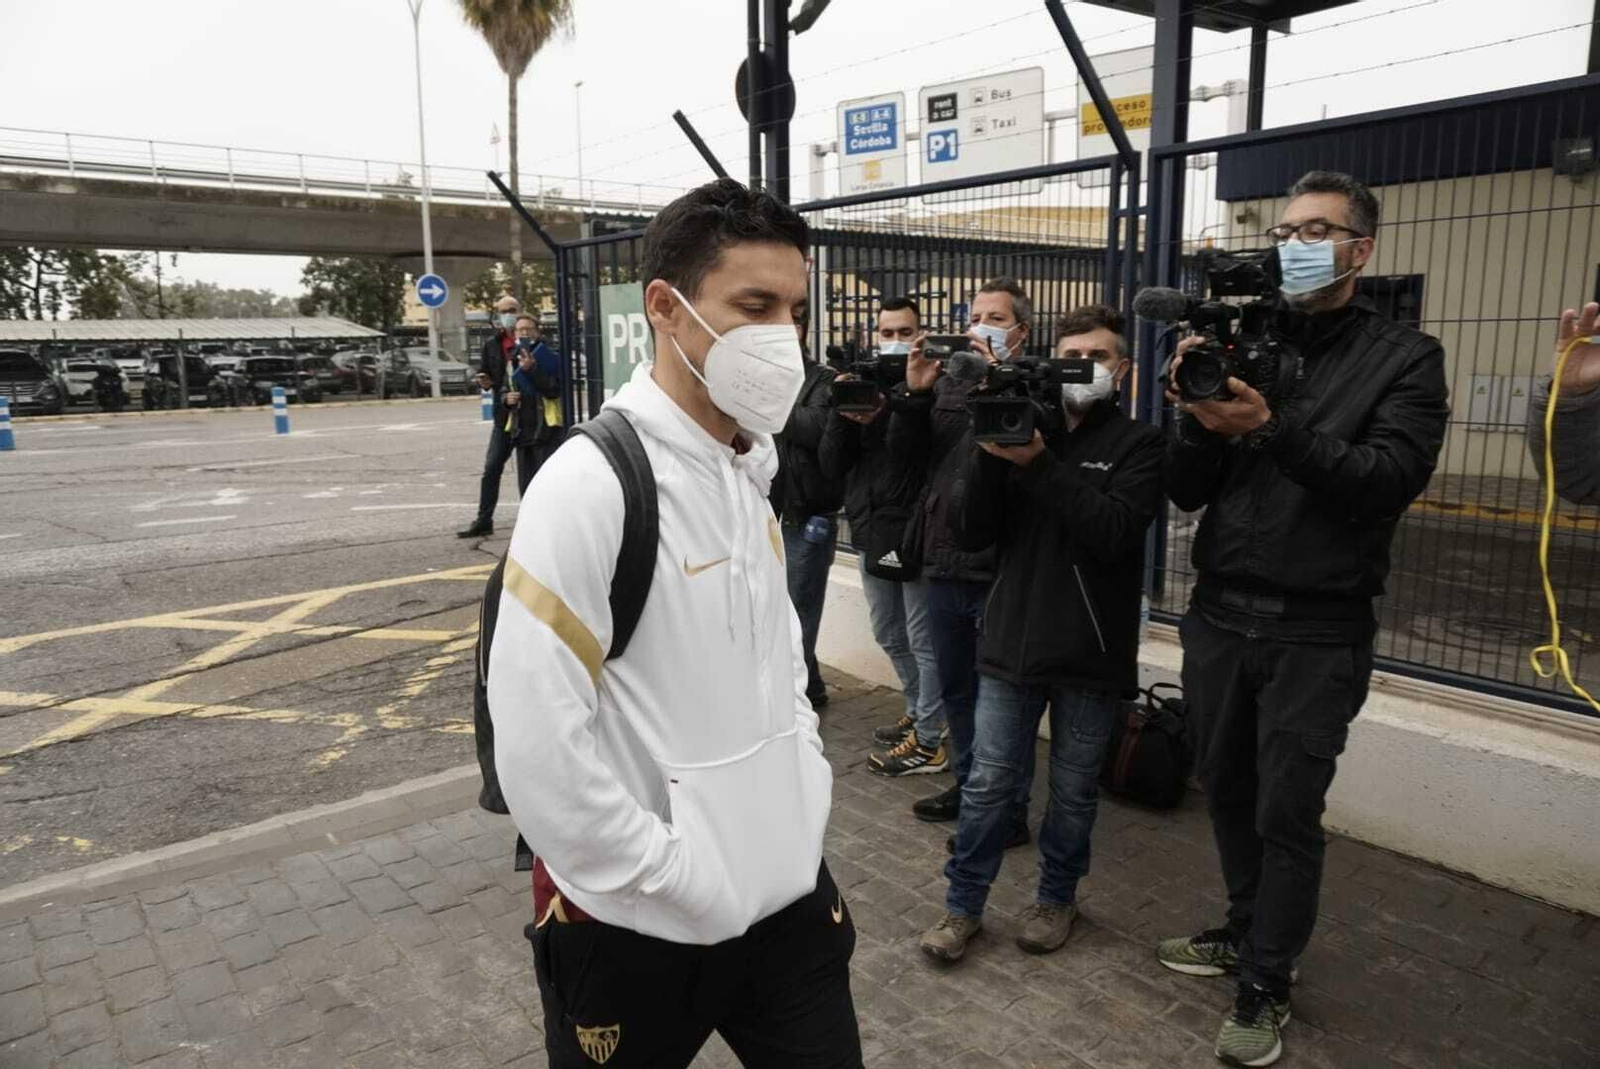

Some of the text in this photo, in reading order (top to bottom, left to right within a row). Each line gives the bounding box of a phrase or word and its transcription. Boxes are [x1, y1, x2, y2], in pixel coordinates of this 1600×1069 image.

[991, 89, 1012, 100] Bus
[1116, 100, 1147, 112] ceso
[854, 122, 888, 136] Sevilla
[992, 116, 1016, 129] Taxi
[850, 135, 892, 150] Córdoba
[930, 132, 957, 160] P1
[608, 312, 649, 364] PR
